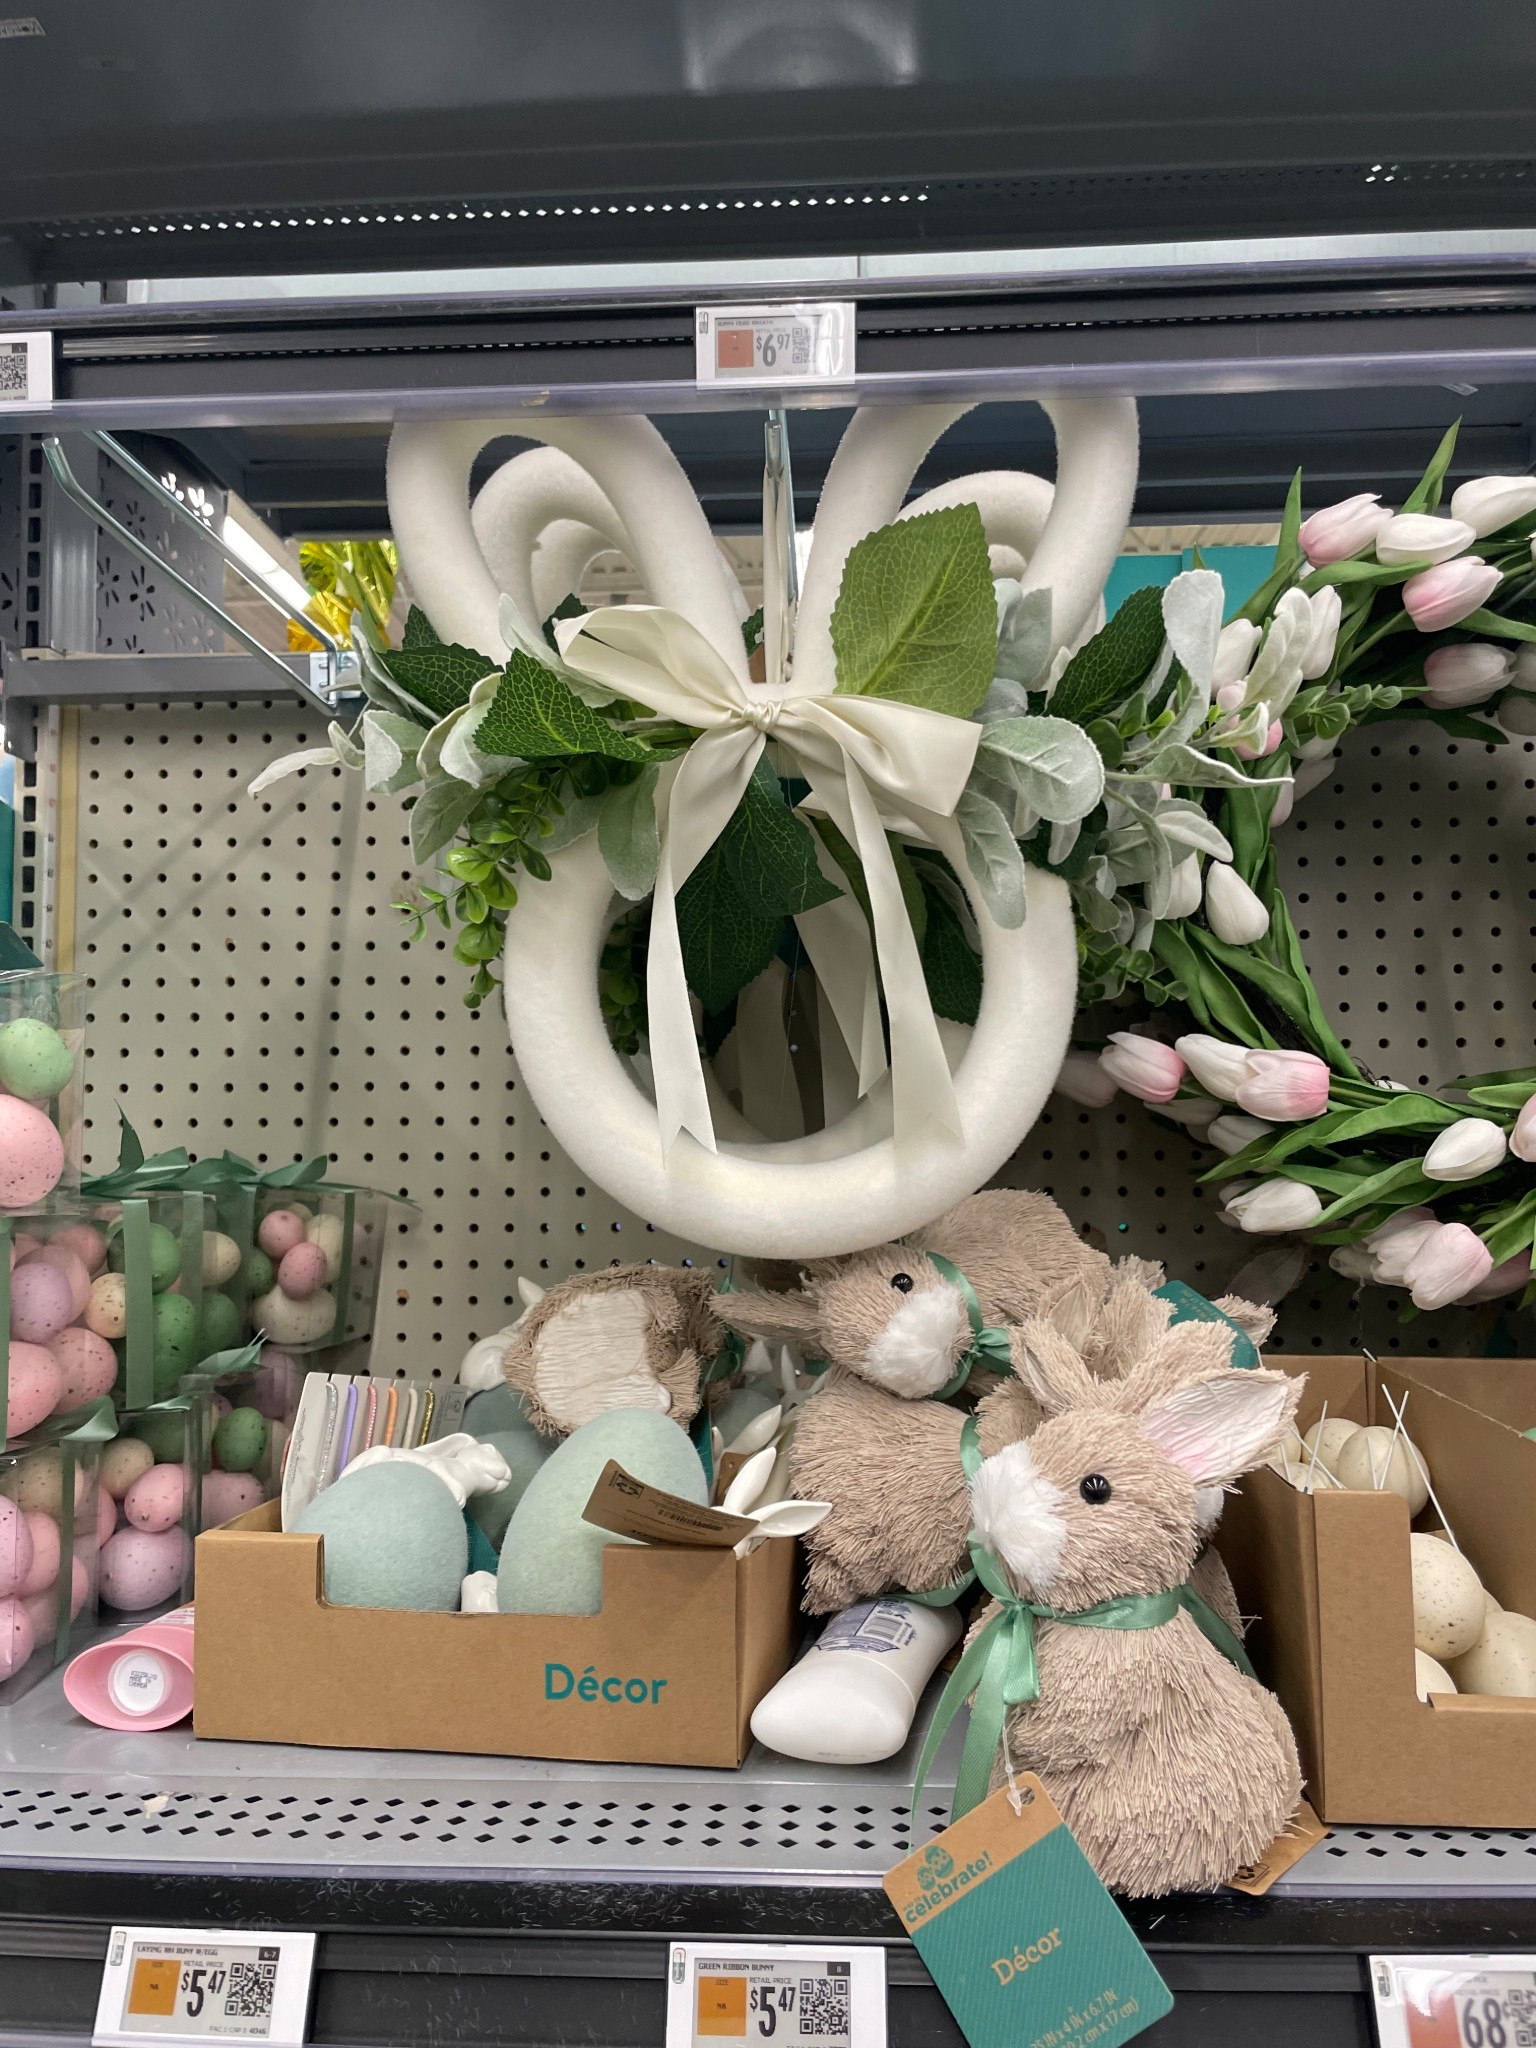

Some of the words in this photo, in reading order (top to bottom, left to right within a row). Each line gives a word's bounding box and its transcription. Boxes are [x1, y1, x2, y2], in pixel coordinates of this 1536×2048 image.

[544, 1663, 668, 1704] Décor
[905, 1850, 993, 1924] celebrate!
[137, 1945, 162, 1953] LAYING
[991, 1927, 1063, 1986] Décor
[698, 1962, 721, 1970] GREEN
[722, 1963, 750, 1971] RIBBON
[751, 1964, 775, 1972] BUNNY
[749, 1976, 771, 1984] RETAIL
